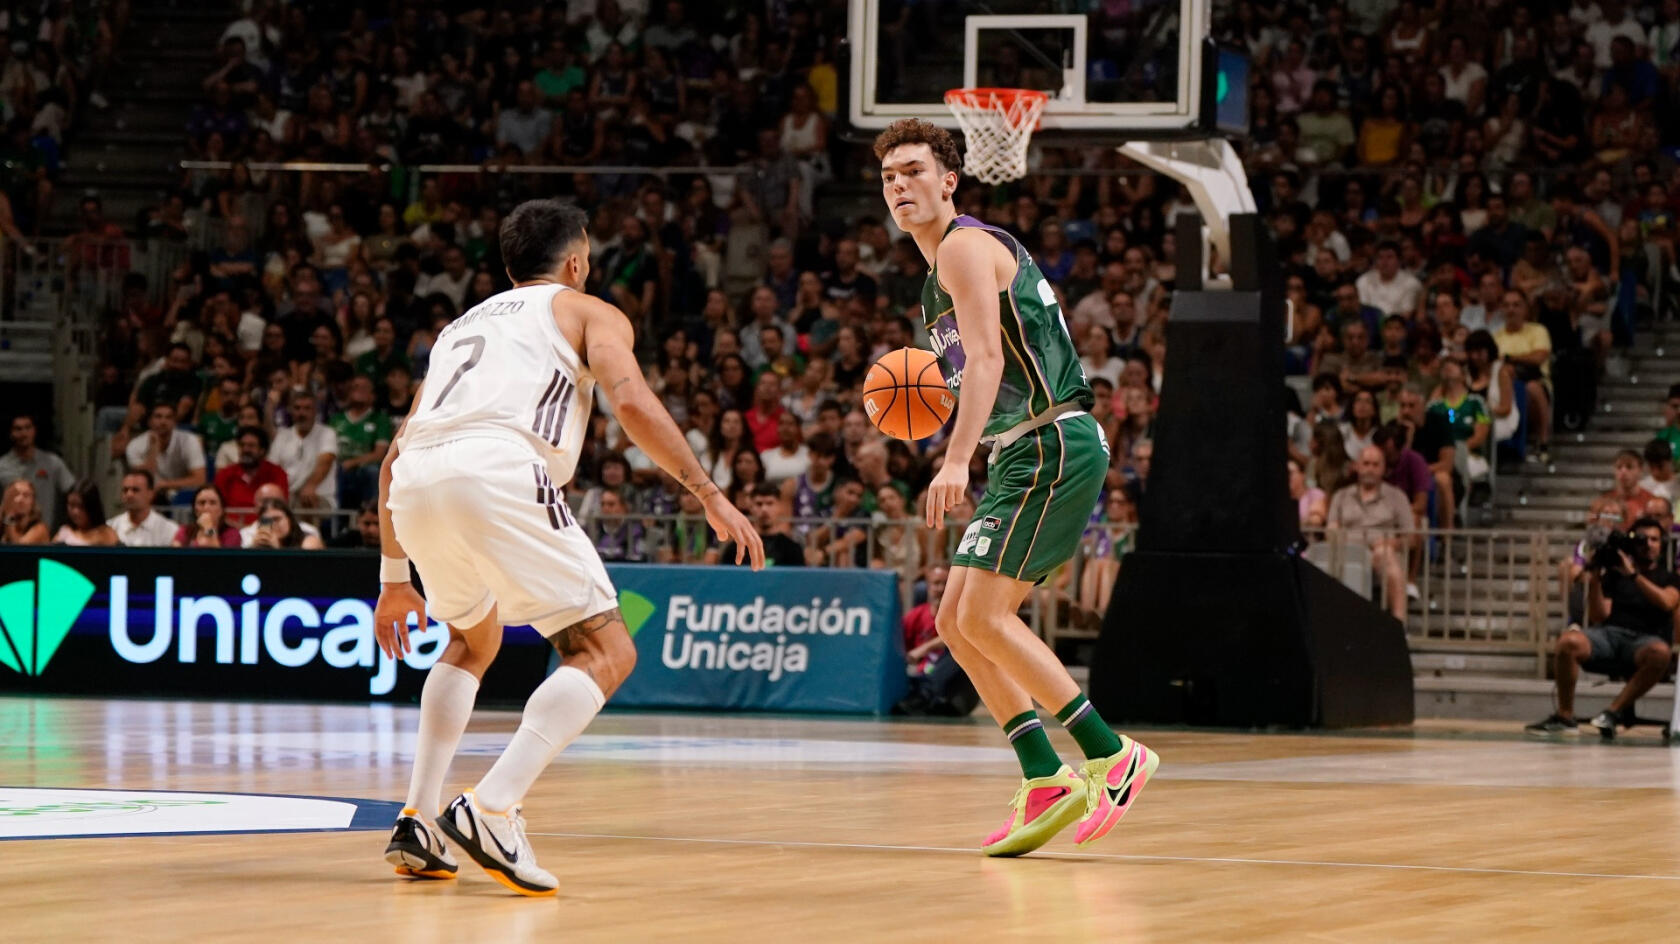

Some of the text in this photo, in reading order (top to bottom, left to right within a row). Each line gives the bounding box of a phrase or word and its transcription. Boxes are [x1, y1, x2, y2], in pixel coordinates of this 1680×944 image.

[431, 335, 486, 410] 7
[666, 596, 872, 636] Fundación
[662, 633, 808, 682] Unicaja
